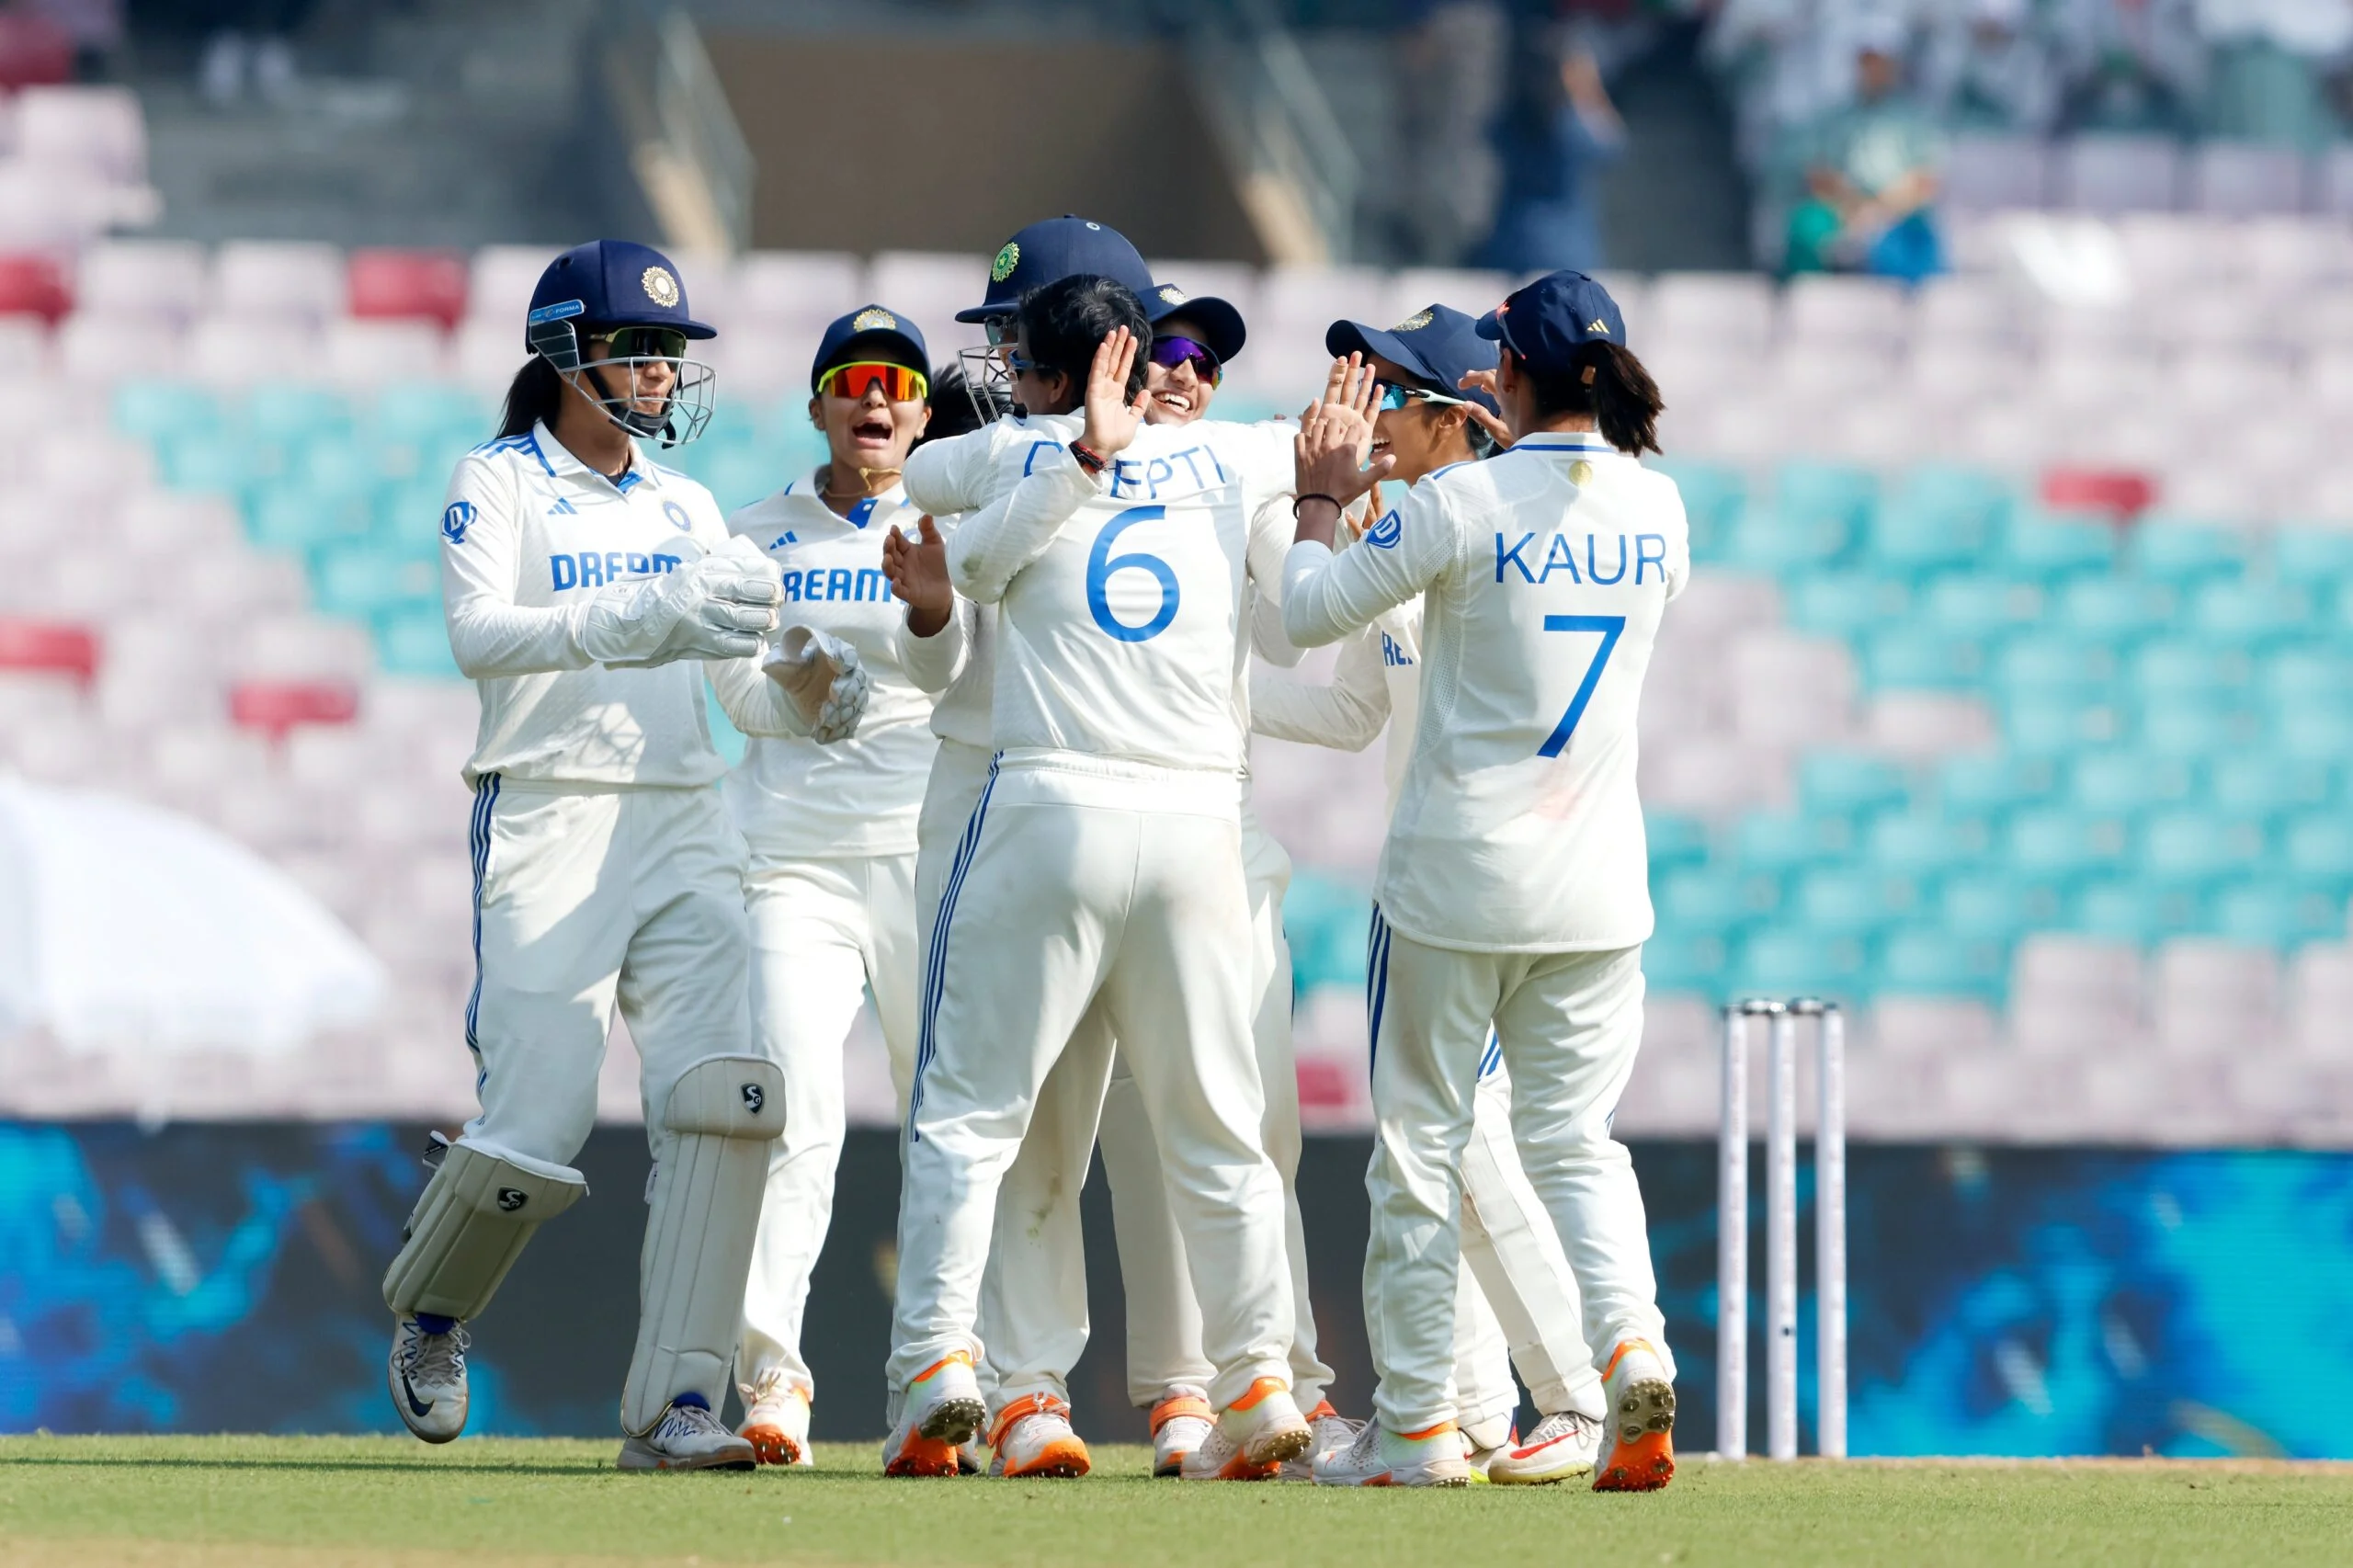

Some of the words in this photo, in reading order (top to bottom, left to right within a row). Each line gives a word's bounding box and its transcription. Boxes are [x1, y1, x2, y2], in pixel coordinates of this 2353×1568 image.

[555, 304, 580, 314] FORMA
[1023, 440, 1227, 500] DEPTI
[1086, 505, 1181, 643] 6
[1495, 532, 1666, 585] KAUR
[1536, 614, 1626, 758] 7
